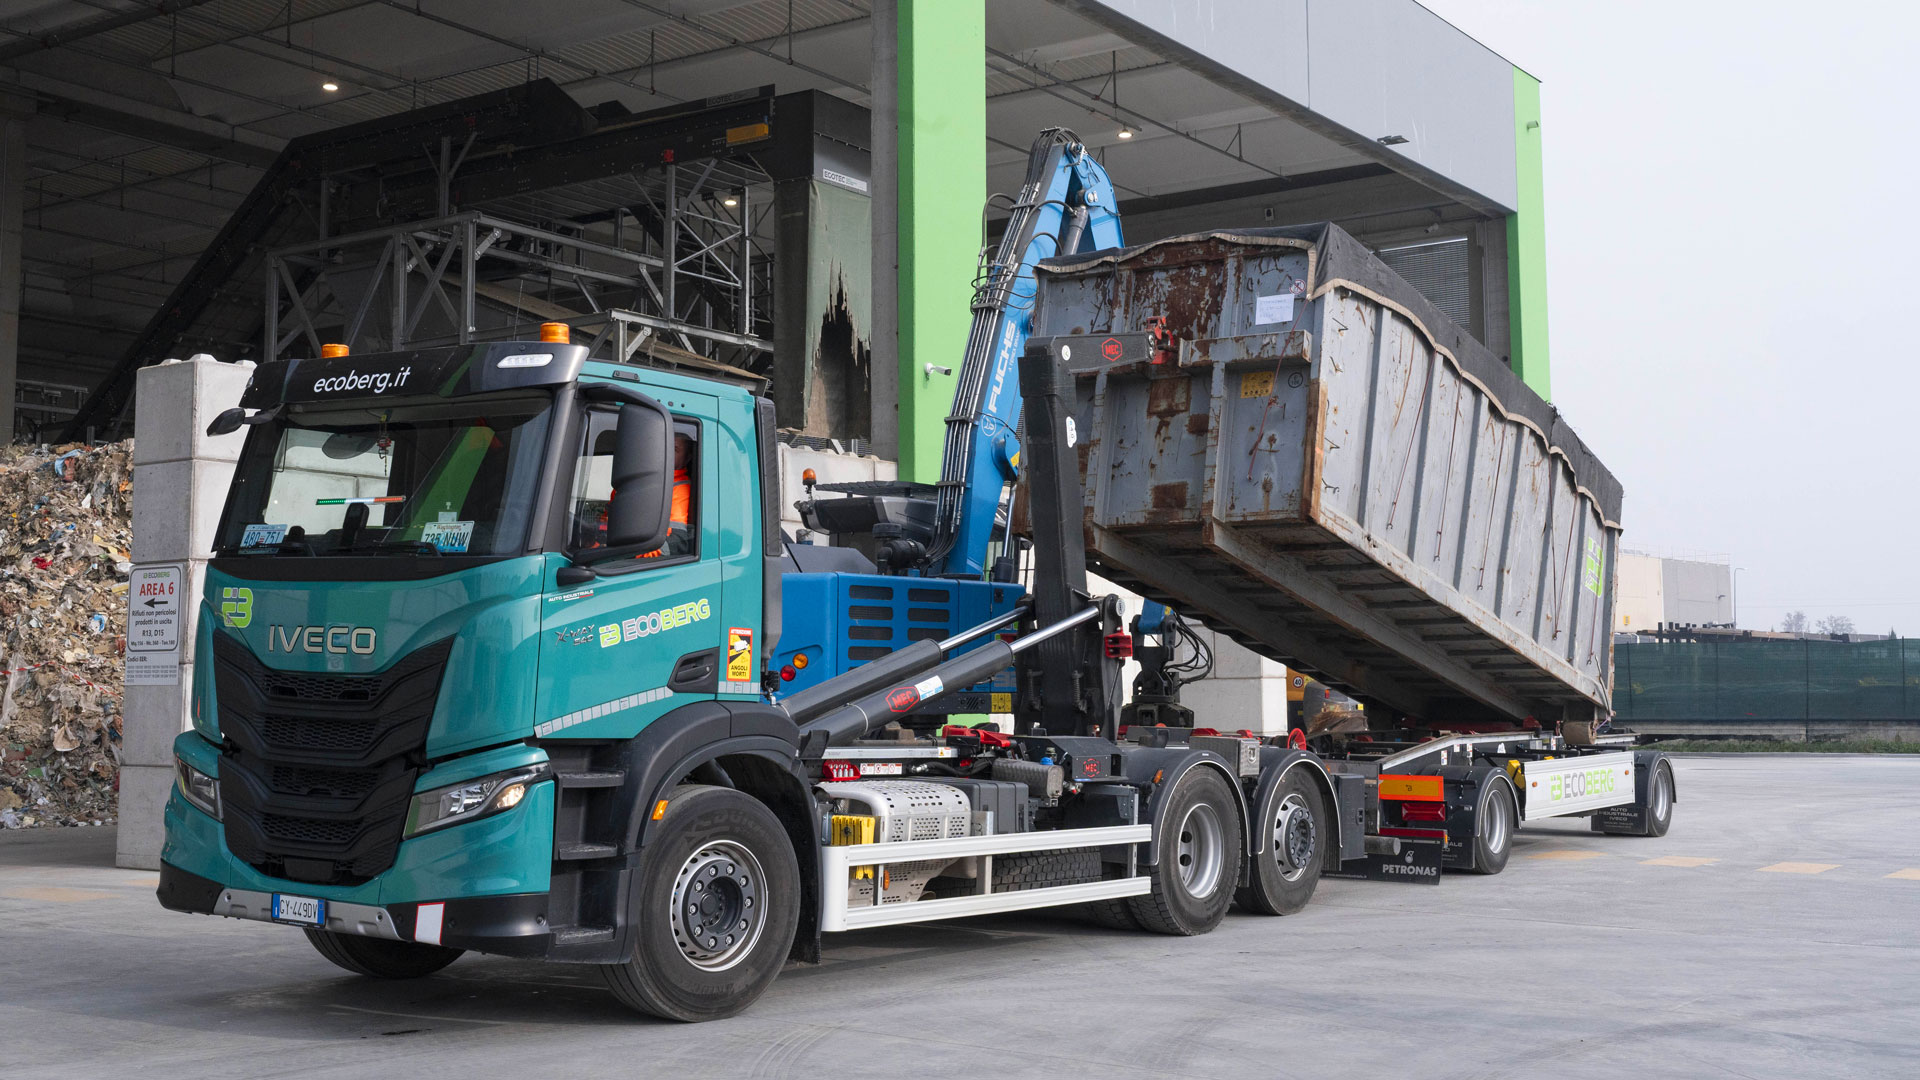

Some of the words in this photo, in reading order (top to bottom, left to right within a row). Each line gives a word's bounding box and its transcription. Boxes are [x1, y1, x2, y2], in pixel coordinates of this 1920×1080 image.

[1105, 344, 1119, 355] MEC
[988, 320, 1016, 413] FUCHS
[313, 366, 411, 394] ecoberg.it
[139, 582, 166, 597] AREA
[168, 581, 175, 595] 6
[155, 608, 177, 617] pericolosi
[622, 598, 711, 642] ECOBERG
[135, 618, 154, 627] prodotti
[153, 629, 165, 637] D15
[268, 624, 377, 655] IVECO
[891, 690, 915, 709] MEC
[1563, 768, 1614, 799] ECOBERG
[1382, 864, 1437, 876] PETRONAS
